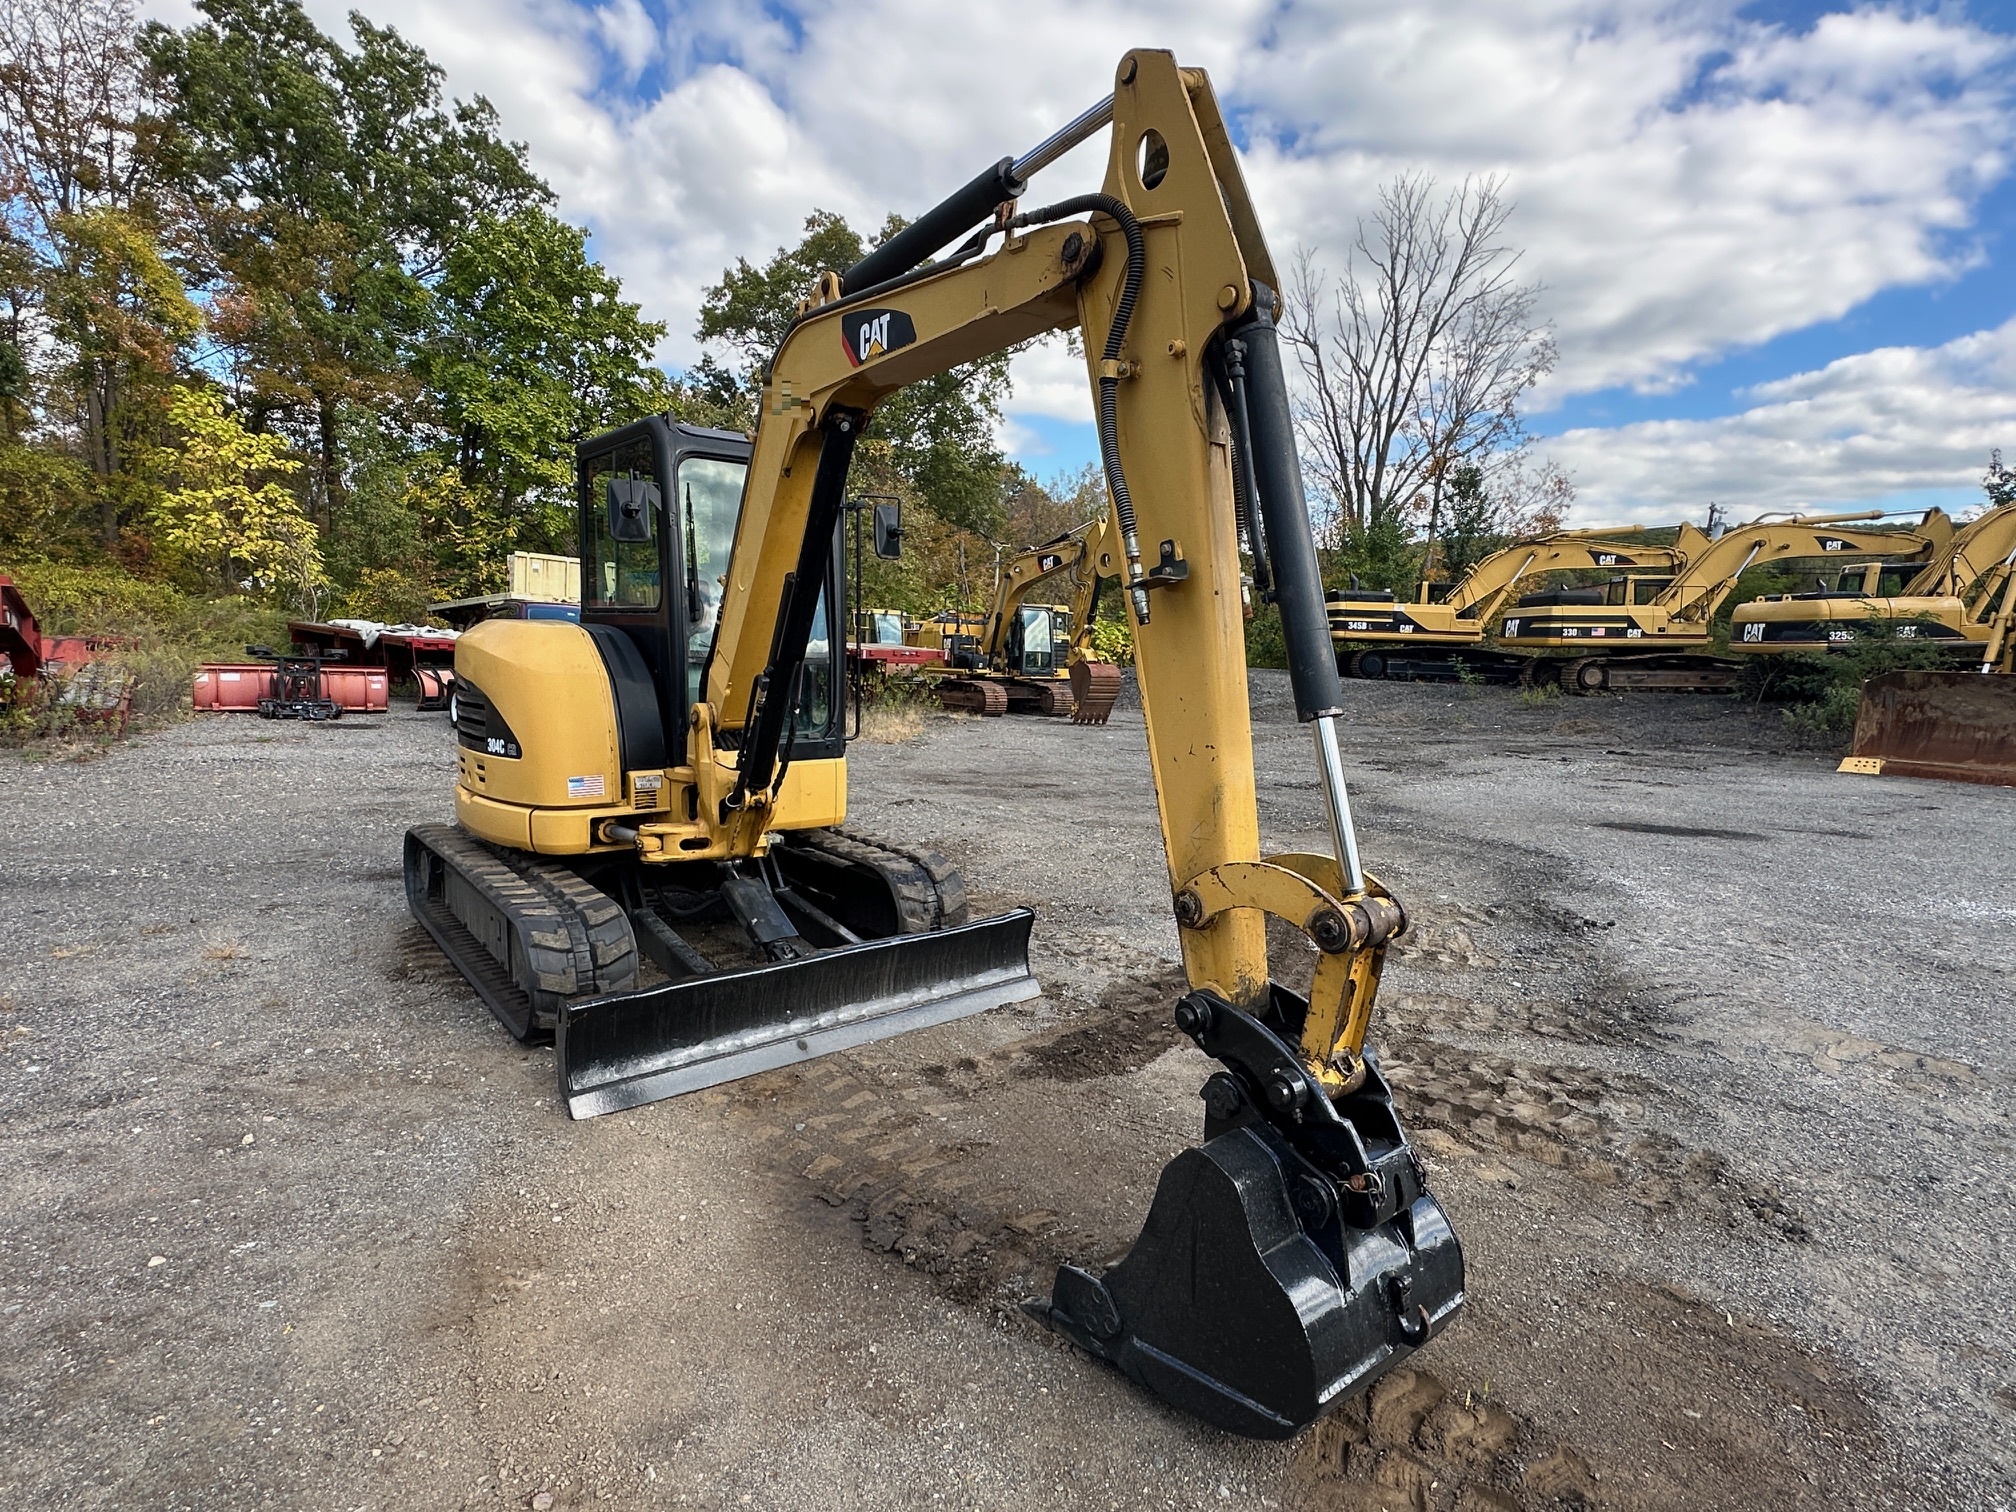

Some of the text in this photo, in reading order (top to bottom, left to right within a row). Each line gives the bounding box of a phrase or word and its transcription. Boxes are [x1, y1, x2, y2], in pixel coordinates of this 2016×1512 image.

[859, 312, 891, 361] CAT
[1826, 540, 1843, 551] CAT
[1043, 555, 1054, 571] CAT
[1599, 554, 1617, 566] CAT
[1348, 622, 1367, 630] 345B
[1399, 624, 1414, 633] CAT
[1505, 619, 1520, 638] CAT
[1562, 628, 1577, 637] 330
[1627, 629, 1643, 638] CAT
[1743, 623, 1766, 642] CAT
[487, 737, 505, 754] 304C
